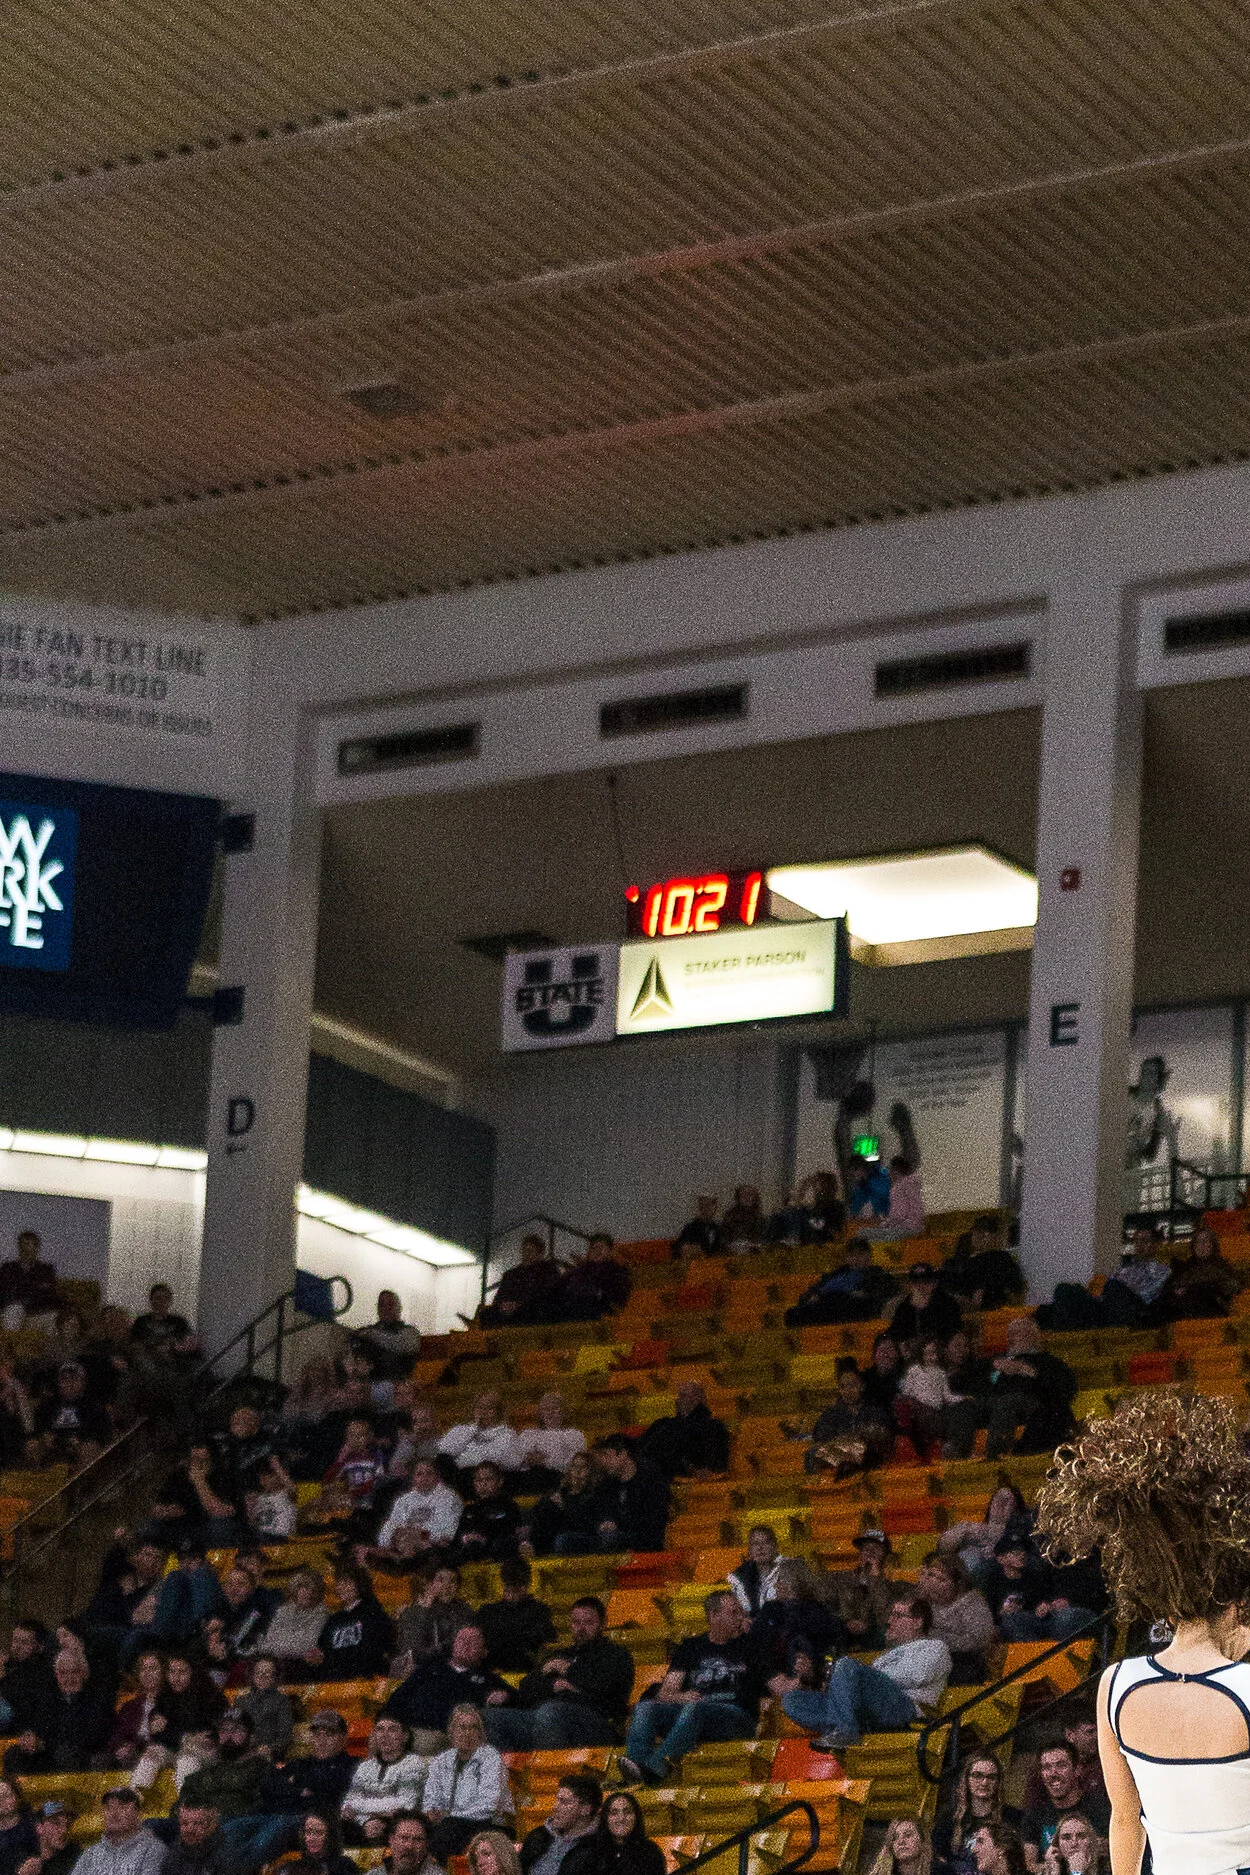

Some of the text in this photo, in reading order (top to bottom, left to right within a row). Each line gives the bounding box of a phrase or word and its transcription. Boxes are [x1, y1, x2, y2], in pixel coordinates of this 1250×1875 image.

[36, 627, 83, 658] FAN
[93, 636, 147, 667] TEXT
[155, 645, 206, 677] LINE
[0, 654, 168, 702] 35-554-1010
[684, 957, 741, 977] STAKER
[746, 950, 808, 971] PARSON
[516, 978, 602, 1012] STATE
[1049, 1005, 1080, 1046] E
[227, 1099, 256, 1135] D
